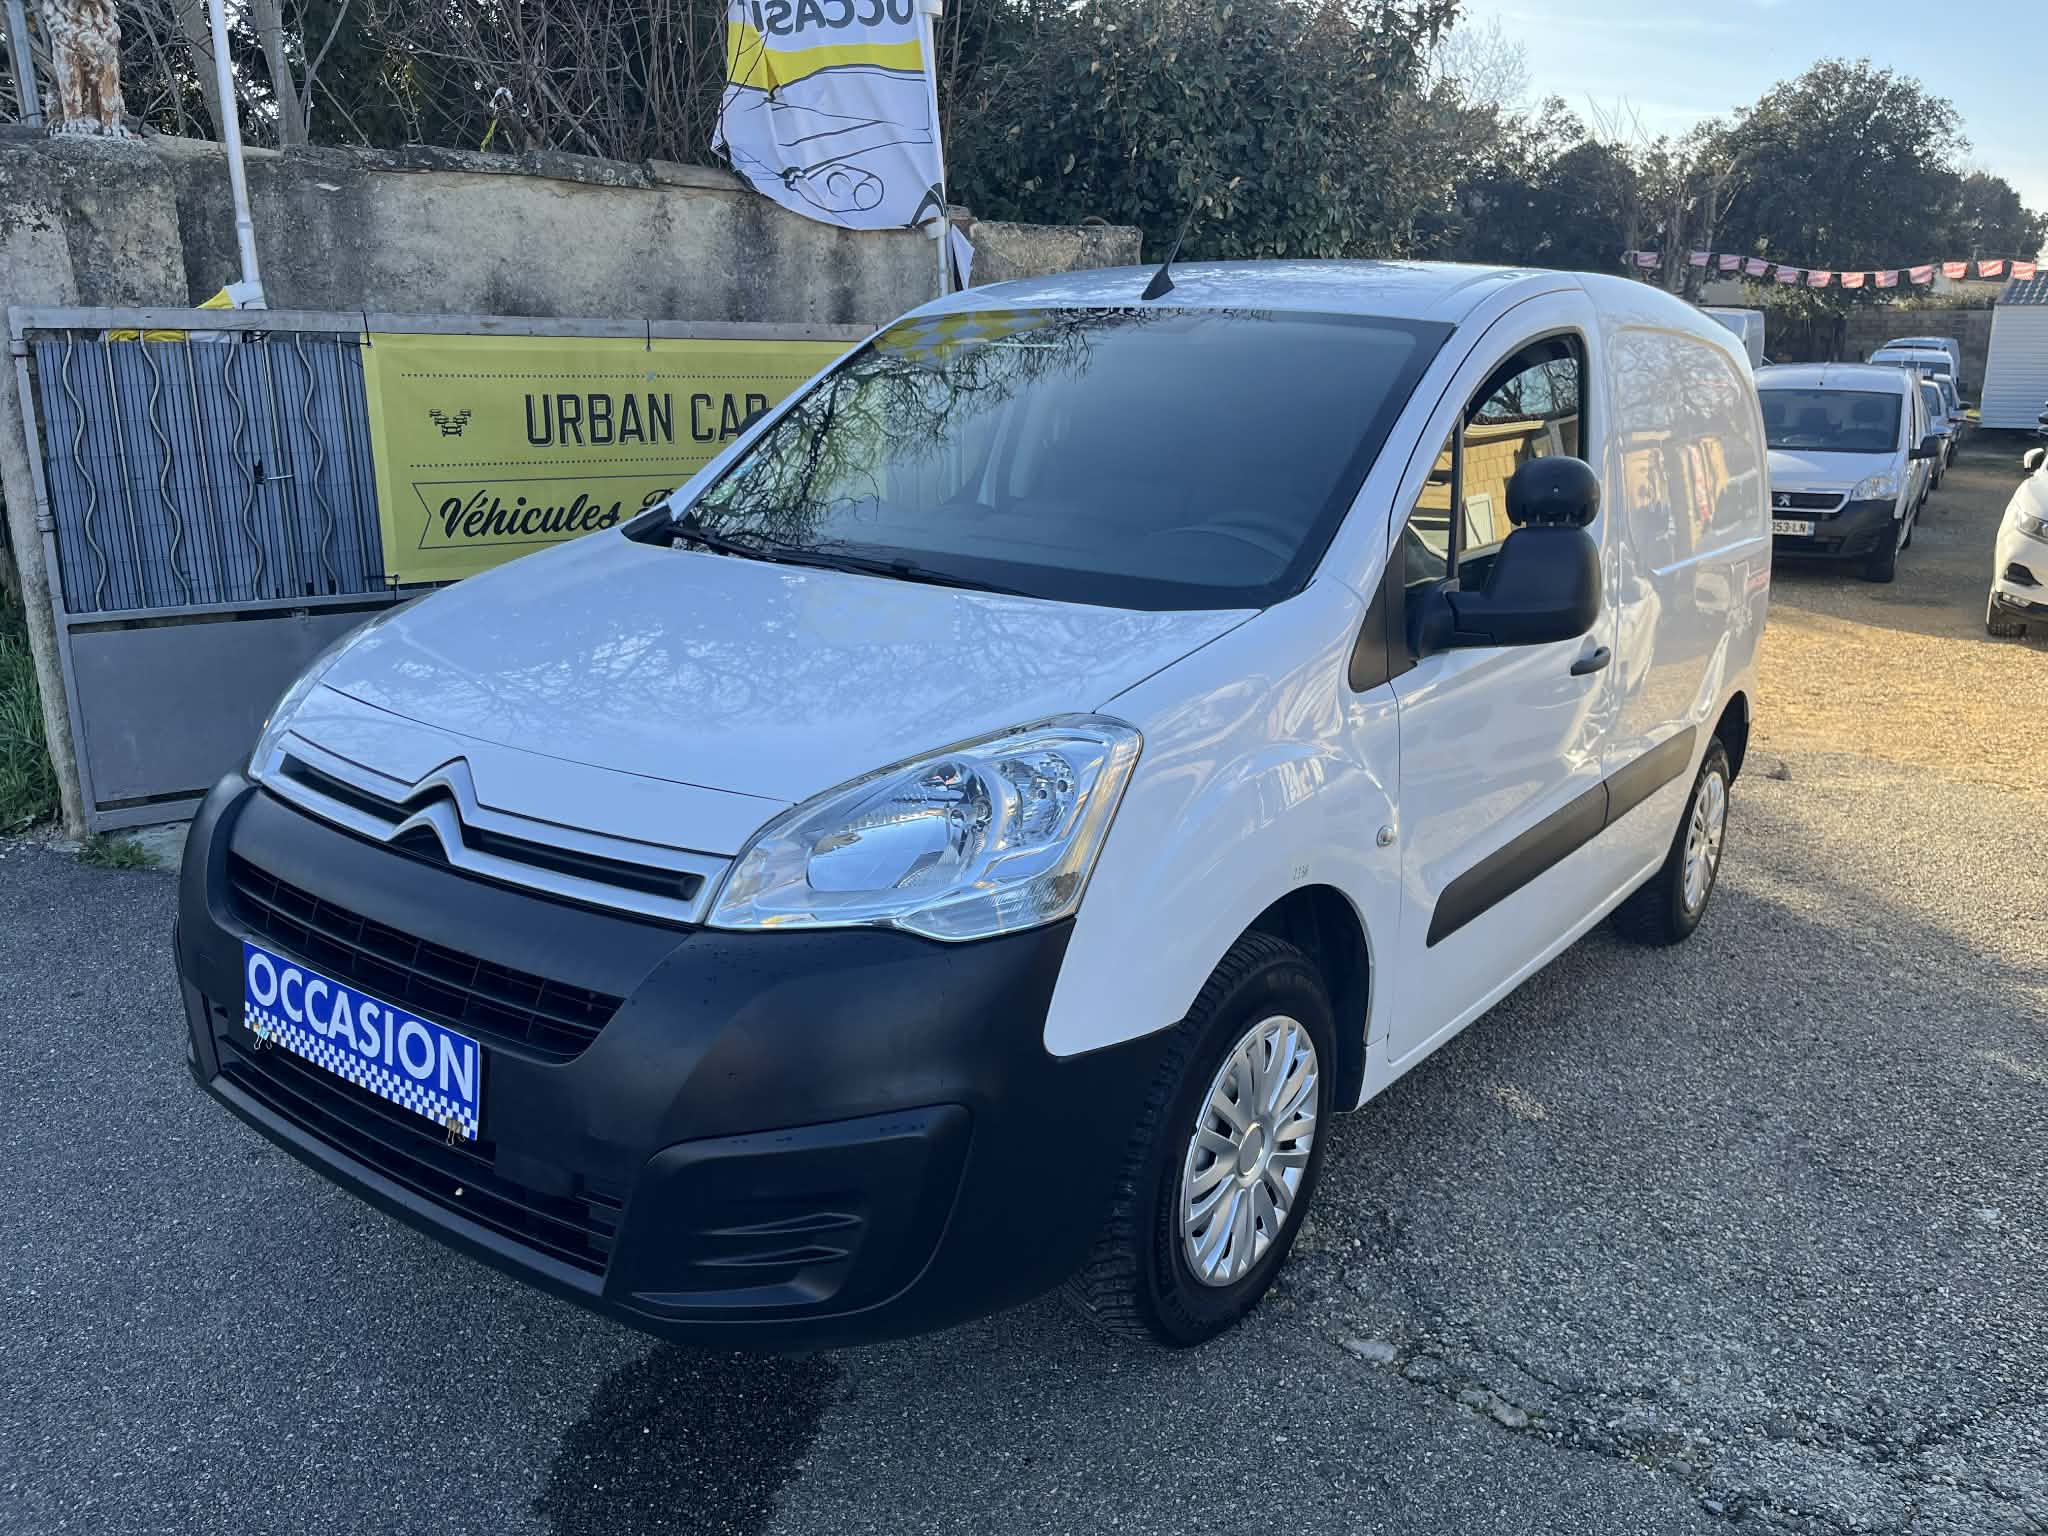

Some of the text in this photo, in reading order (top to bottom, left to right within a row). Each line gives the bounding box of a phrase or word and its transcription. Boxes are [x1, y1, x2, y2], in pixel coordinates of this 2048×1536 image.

[524, 393, 675, 447] URBAN
[438, 489, 621, 539] Véhicules
[248, 952, 474, 1102] OCCASION
